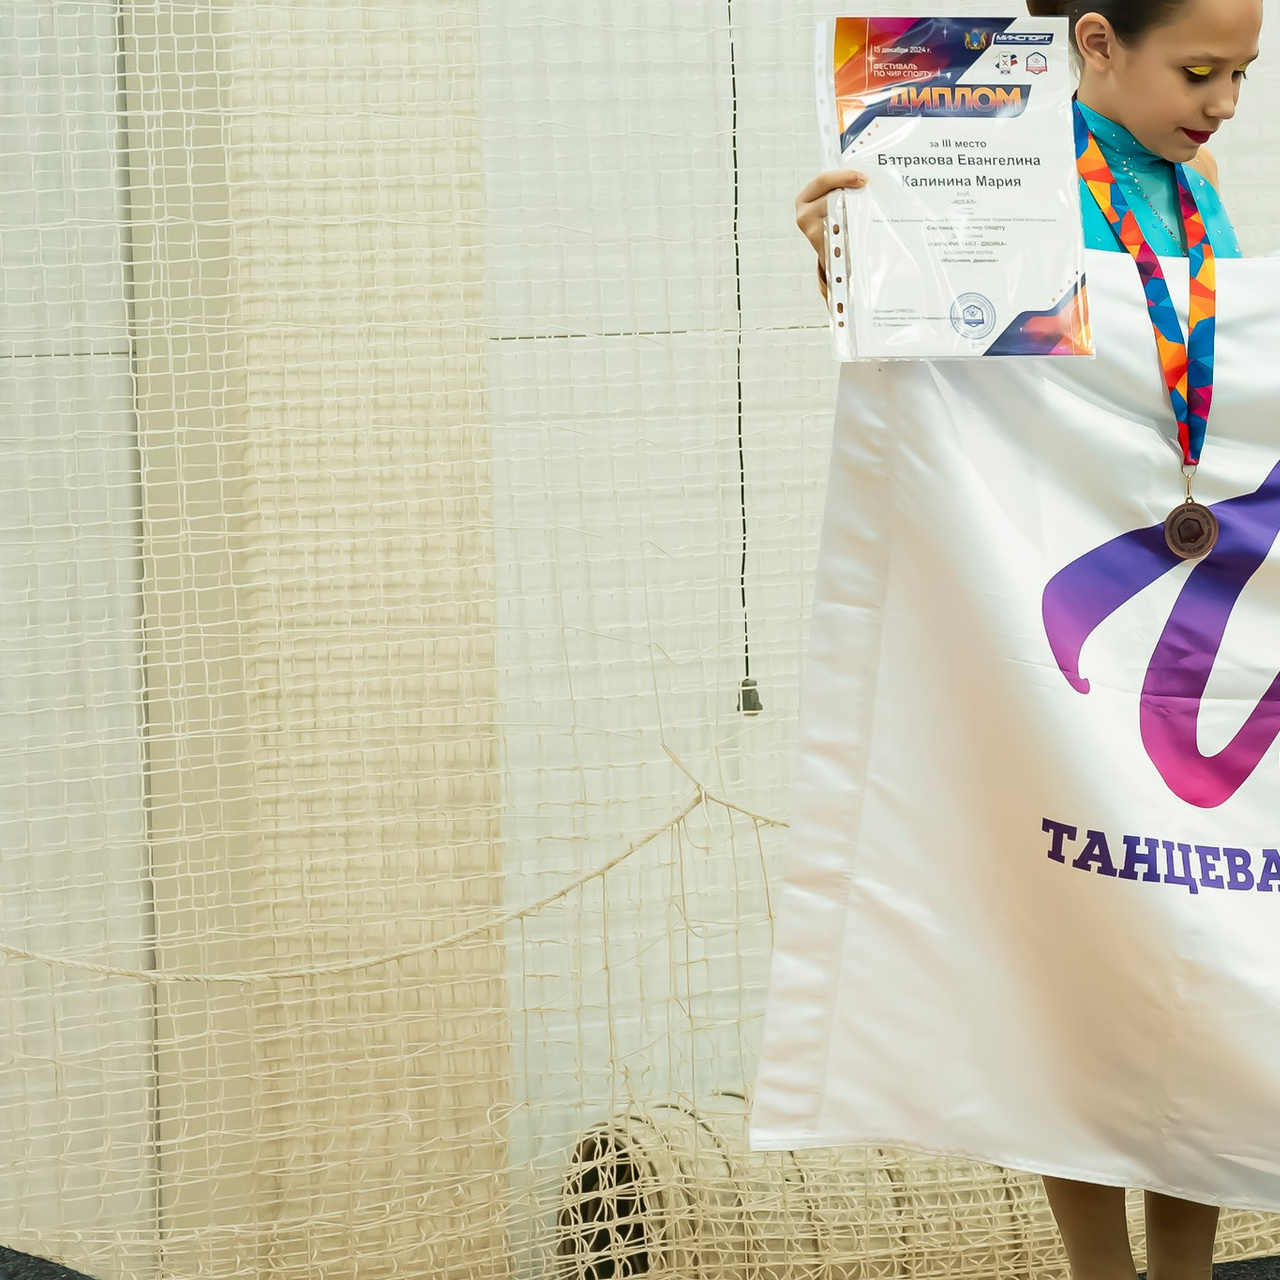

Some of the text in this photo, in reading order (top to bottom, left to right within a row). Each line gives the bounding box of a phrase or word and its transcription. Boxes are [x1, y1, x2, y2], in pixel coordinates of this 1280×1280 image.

[909, 46, 926, 54] 2024
[873, 62, 918, 70] ФЕСТИВАЛЬ
[902, 70, 933, 78] СПОРТУ
[888, 87, 1021, 112] ДИПЛОМ
[877, 153, 1041, 168] Батракова Евангелина
[901, 175, 1022, 189] Калинина Мария
